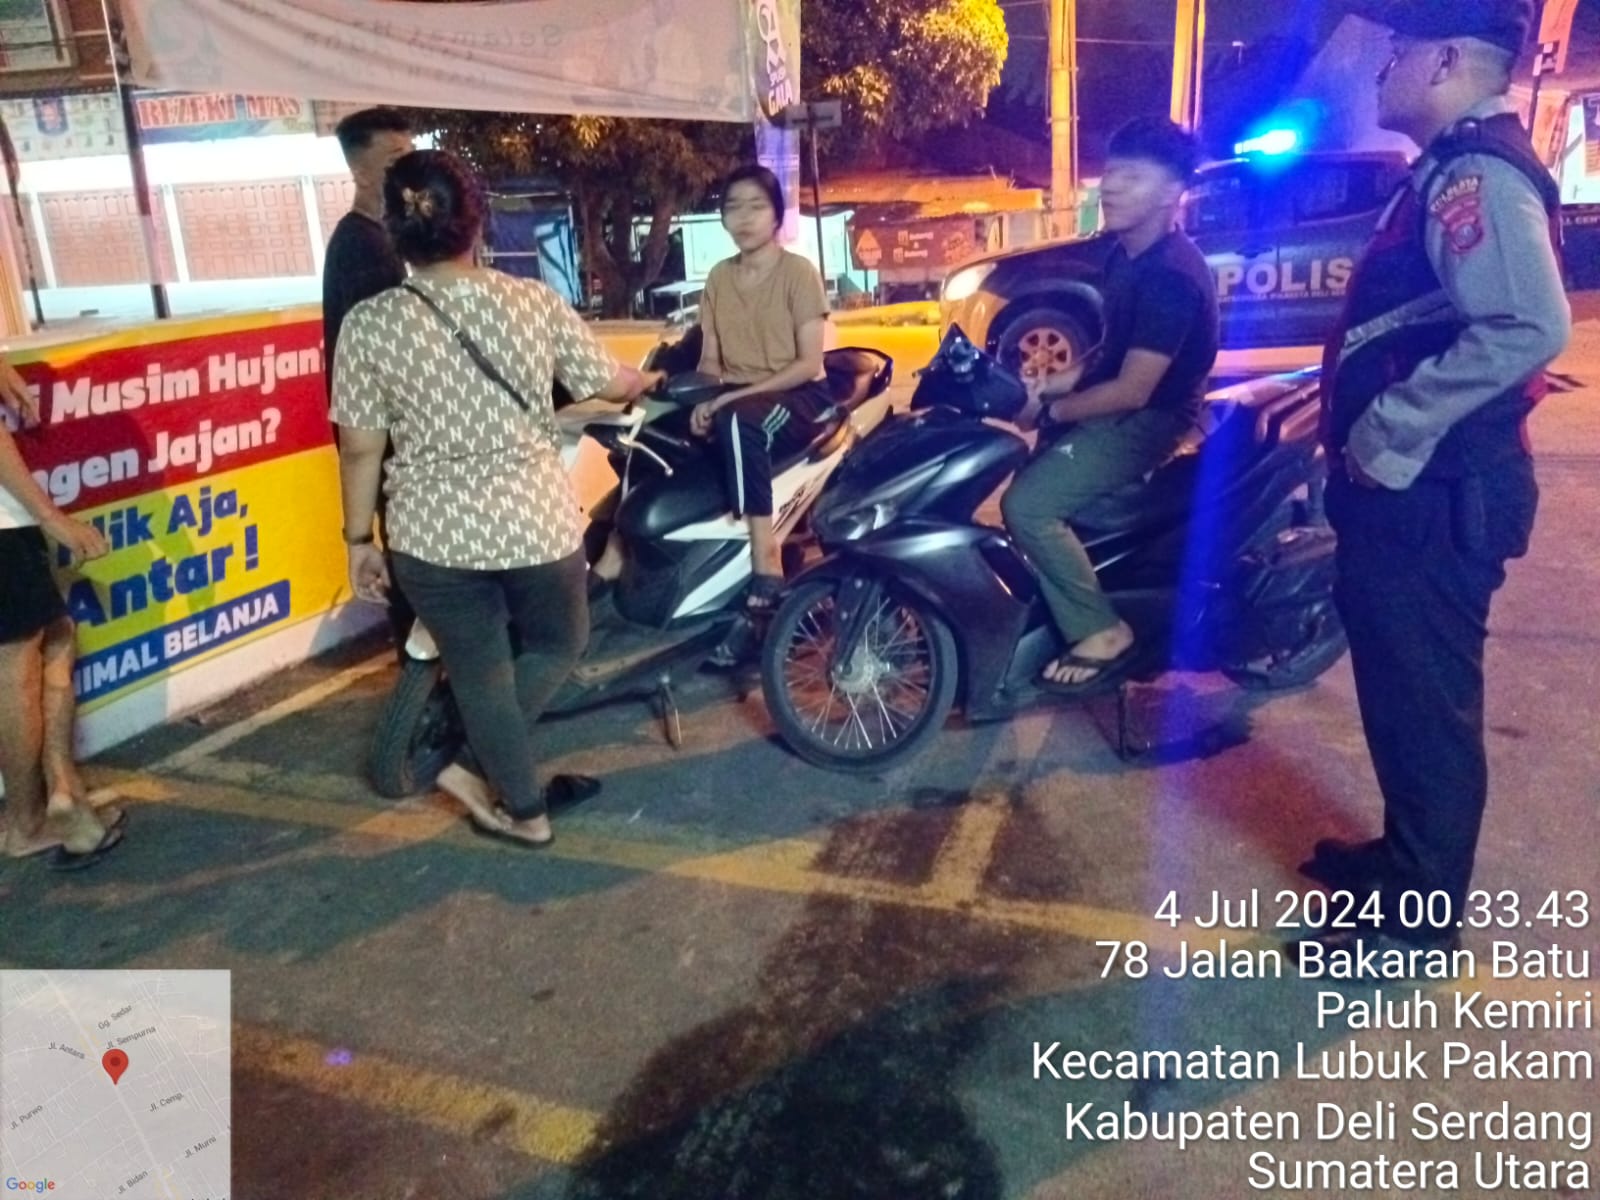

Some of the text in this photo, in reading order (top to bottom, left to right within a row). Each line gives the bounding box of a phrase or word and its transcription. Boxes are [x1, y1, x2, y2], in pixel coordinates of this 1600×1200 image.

[51, 362, 200, 423] Musim
[148, 407, 282, 473] Jajan?
[167, 485, 248, 537] Aja,
[68, 523, 259, 628] Antar !
[163, 592, 279, 659] BELANJA
